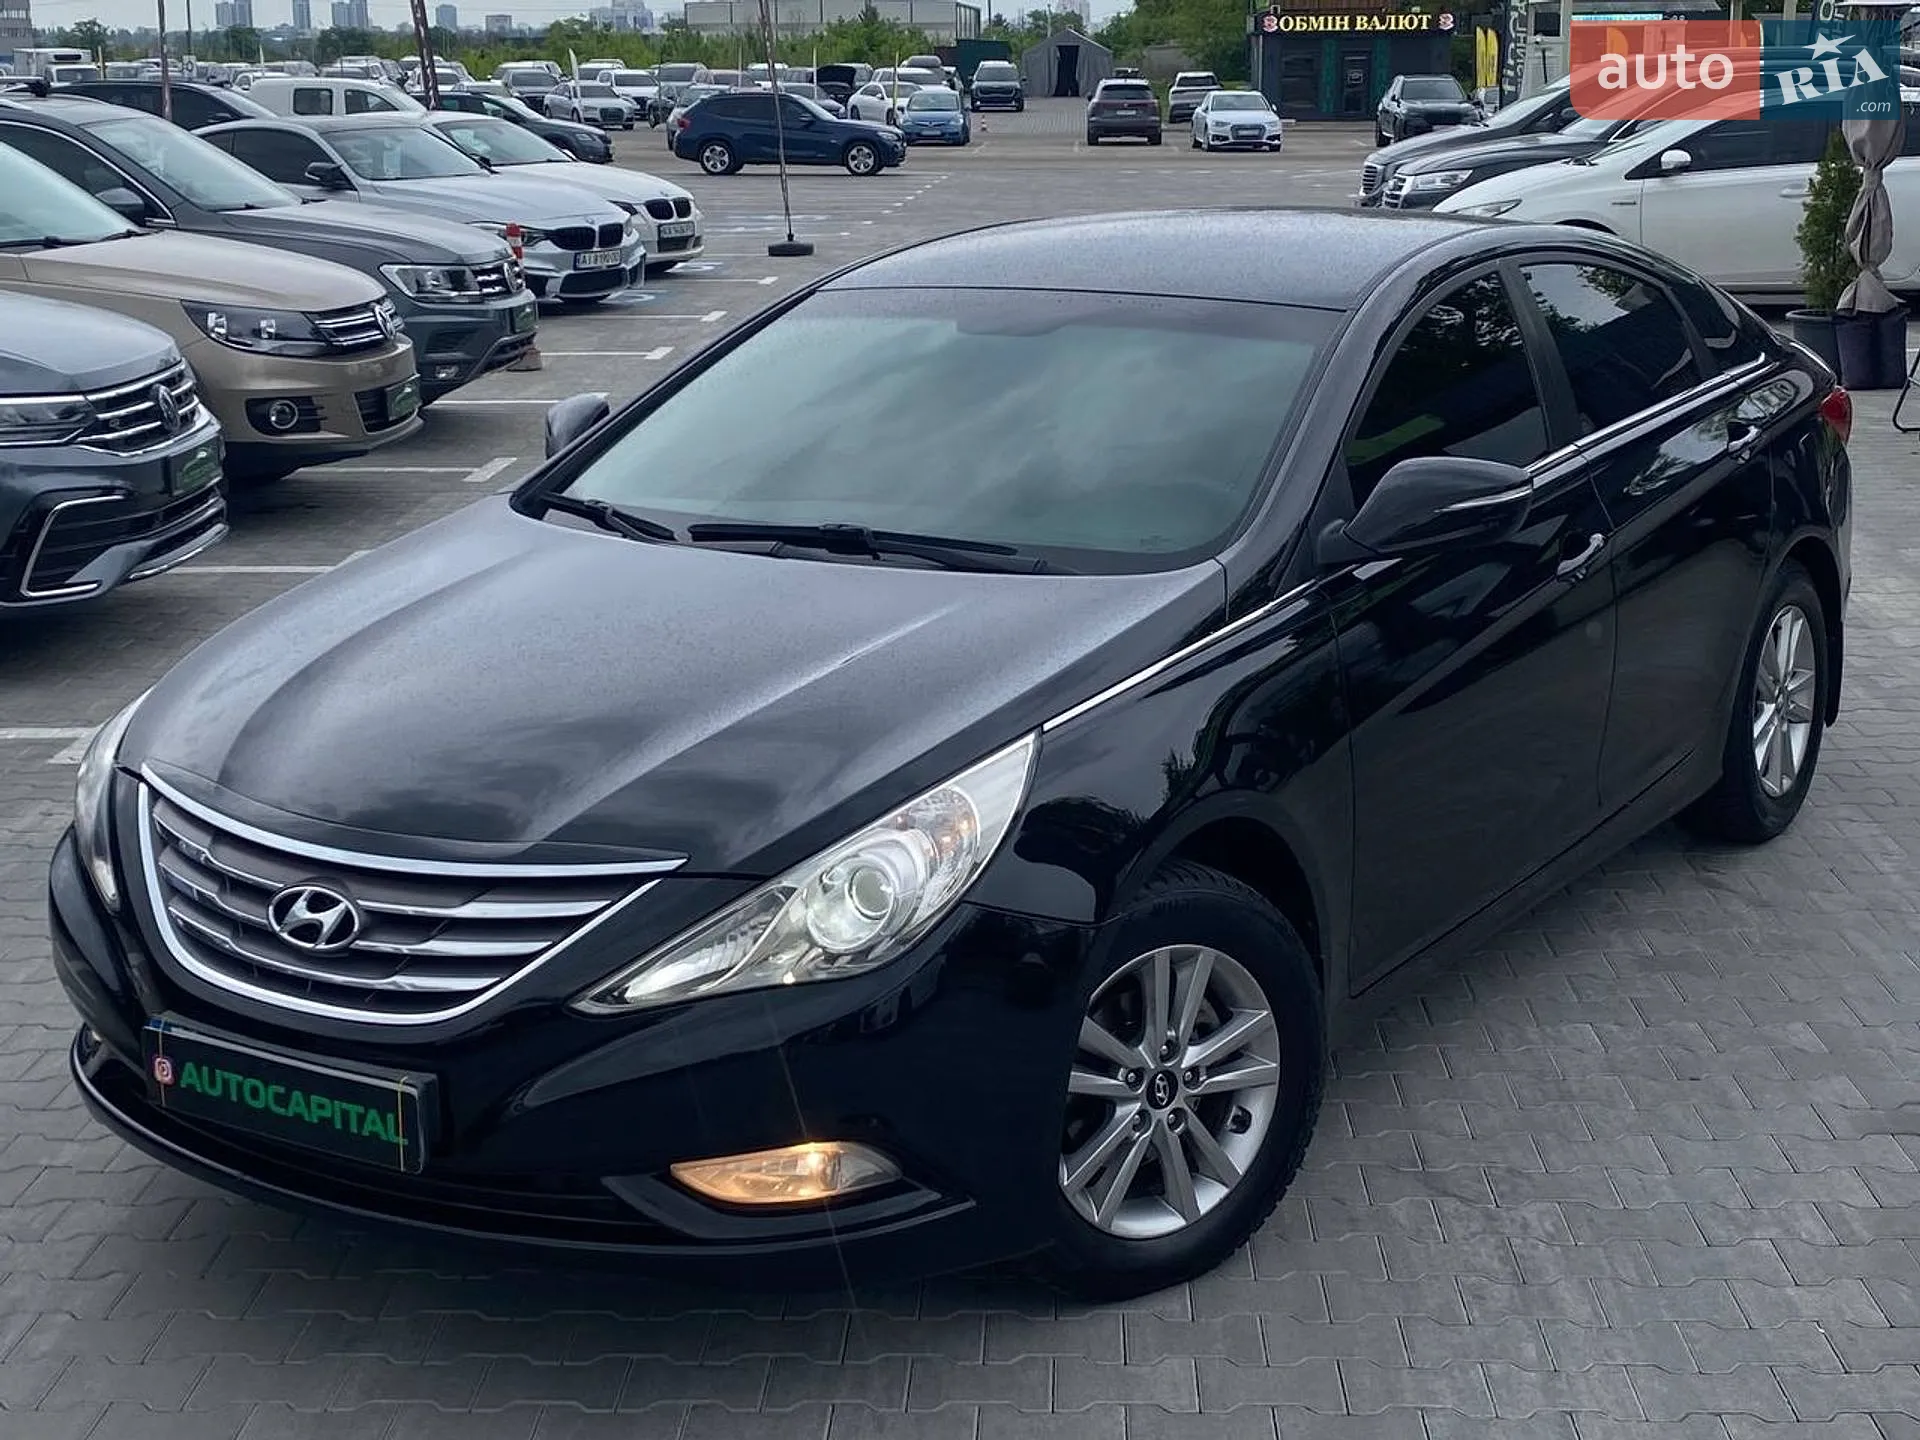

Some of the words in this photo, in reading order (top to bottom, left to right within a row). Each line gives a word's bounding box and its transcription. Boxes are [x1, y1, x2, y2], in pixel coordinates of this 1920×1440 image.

[1279, 15, 1350, 31] ОБМІН
[1354, 14, 1432, 31] ВАЛЮТ
[180, 1062, 409, 1145] AUTOCAPITAL
